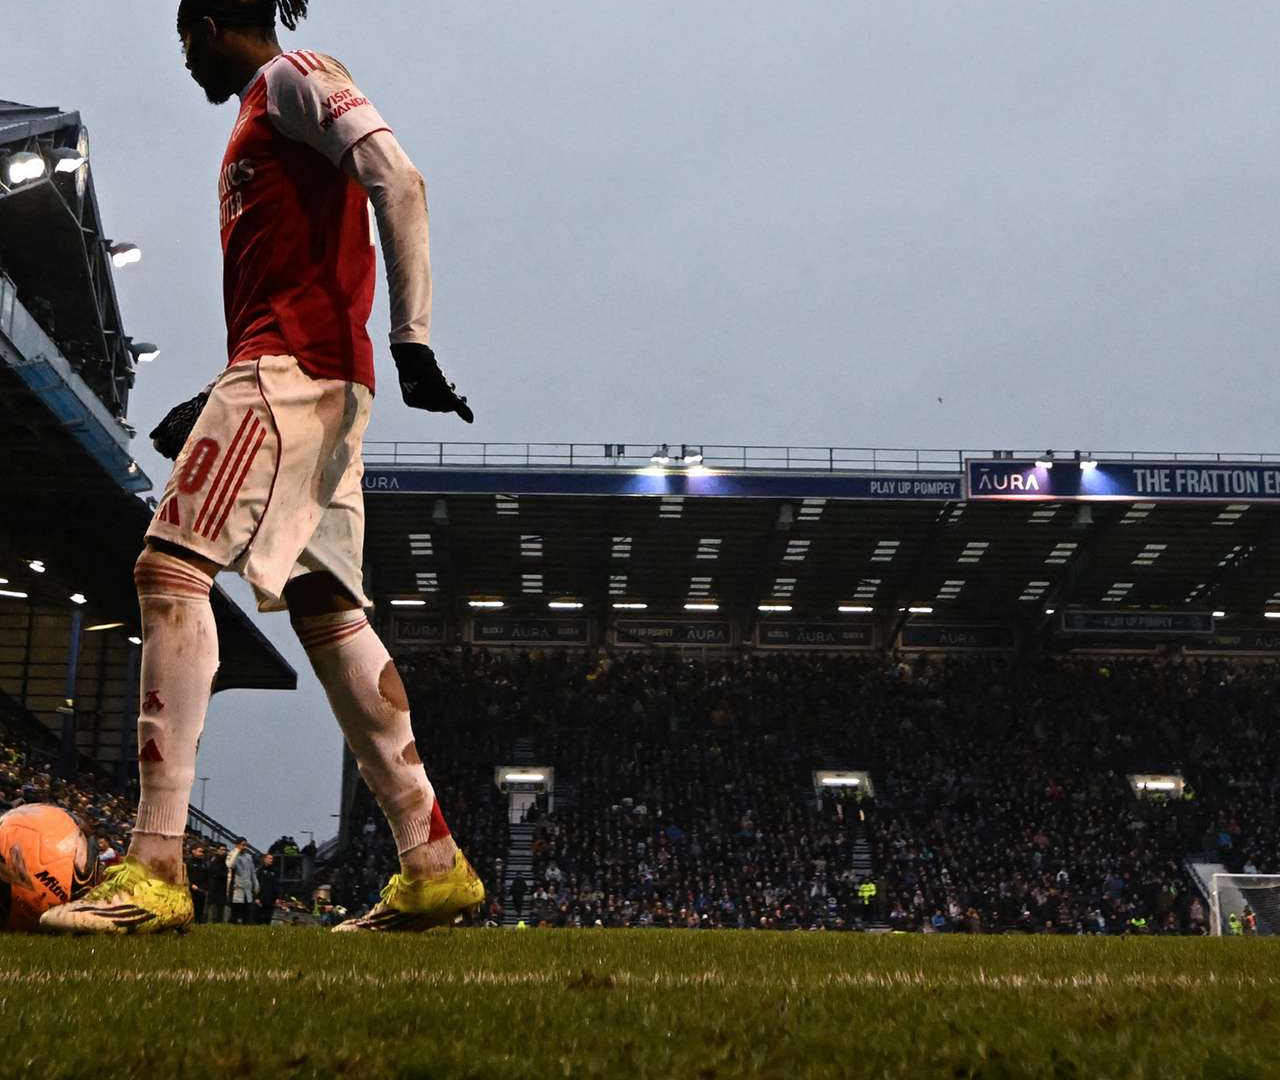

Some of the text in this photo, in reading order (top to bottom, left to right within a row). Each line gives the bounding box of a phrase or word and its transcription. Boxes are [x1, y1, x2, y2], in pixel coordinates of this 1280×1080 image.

[322, 89, 352, 109] VISIT
[364, 476, 400, 489] URA
[870, 481, 956, 495] PLAY UP POMPEY
[1133, 469, 1171, 492] THE
[1176, 470, 1259, 494] FRATTON
